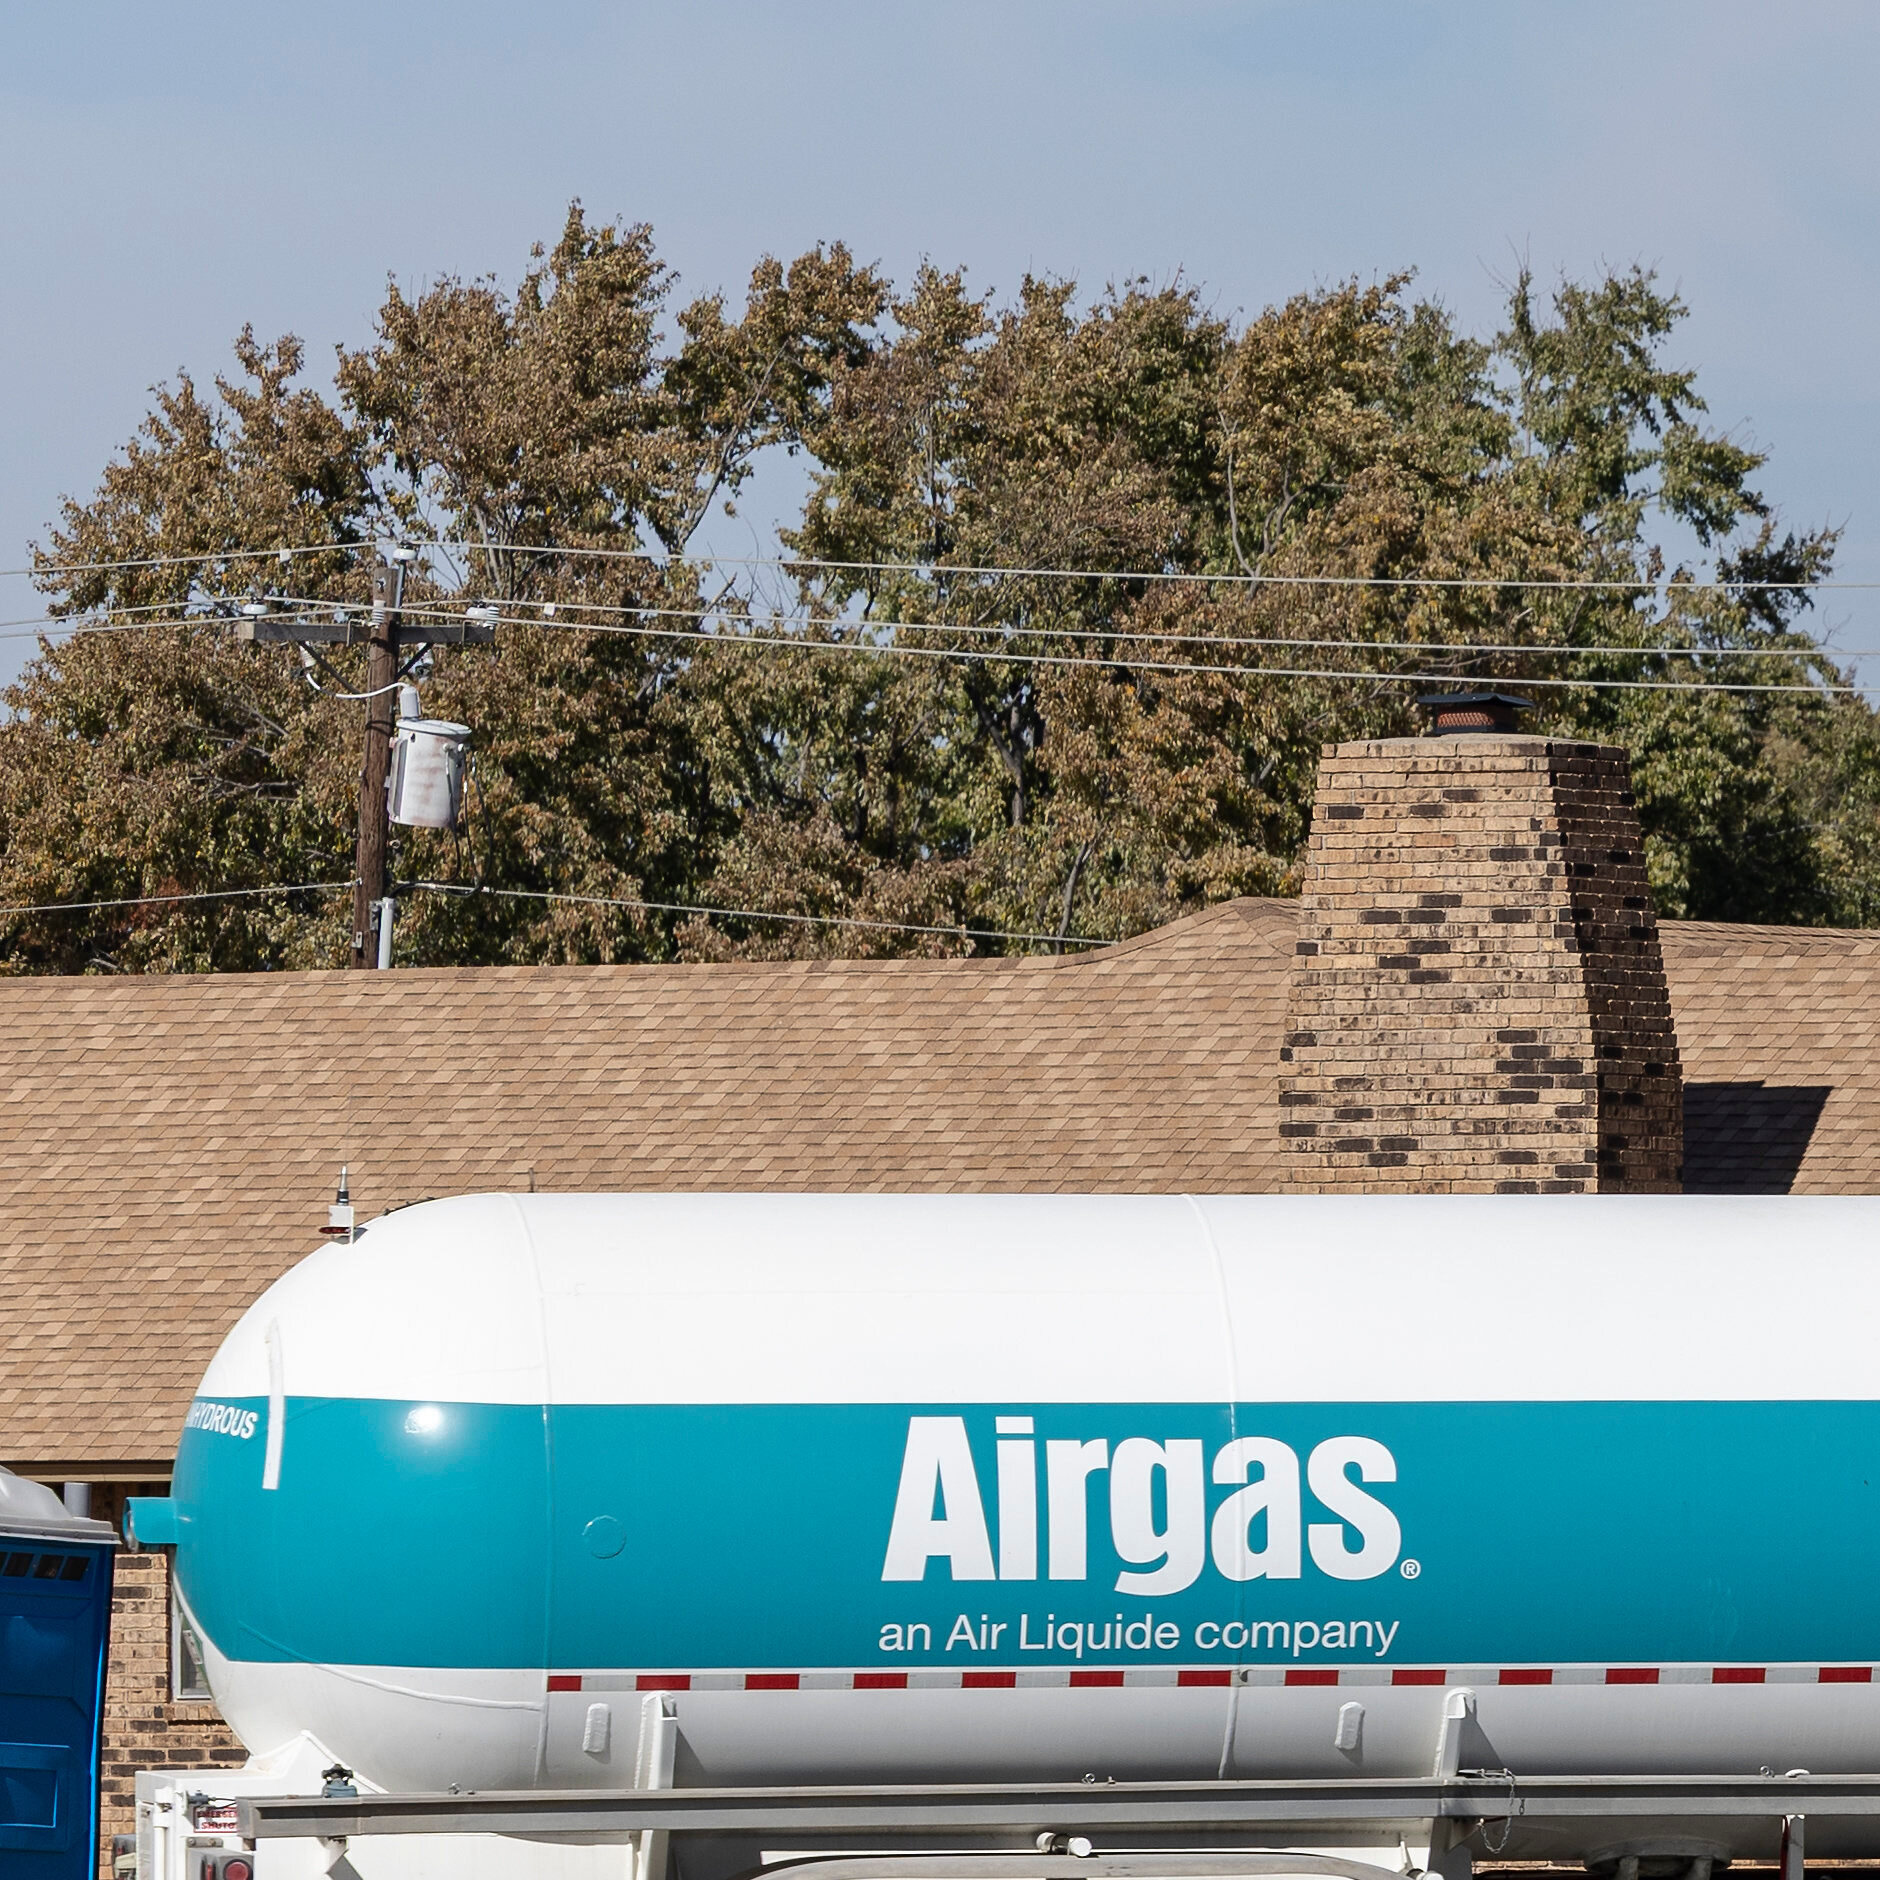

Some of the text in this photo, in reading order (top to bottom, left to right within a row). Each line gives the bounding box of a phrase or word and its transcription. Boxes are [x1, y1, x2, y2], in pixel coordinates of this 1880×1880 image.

[878, 1613, 1401, 1659] an Air Liquide company
